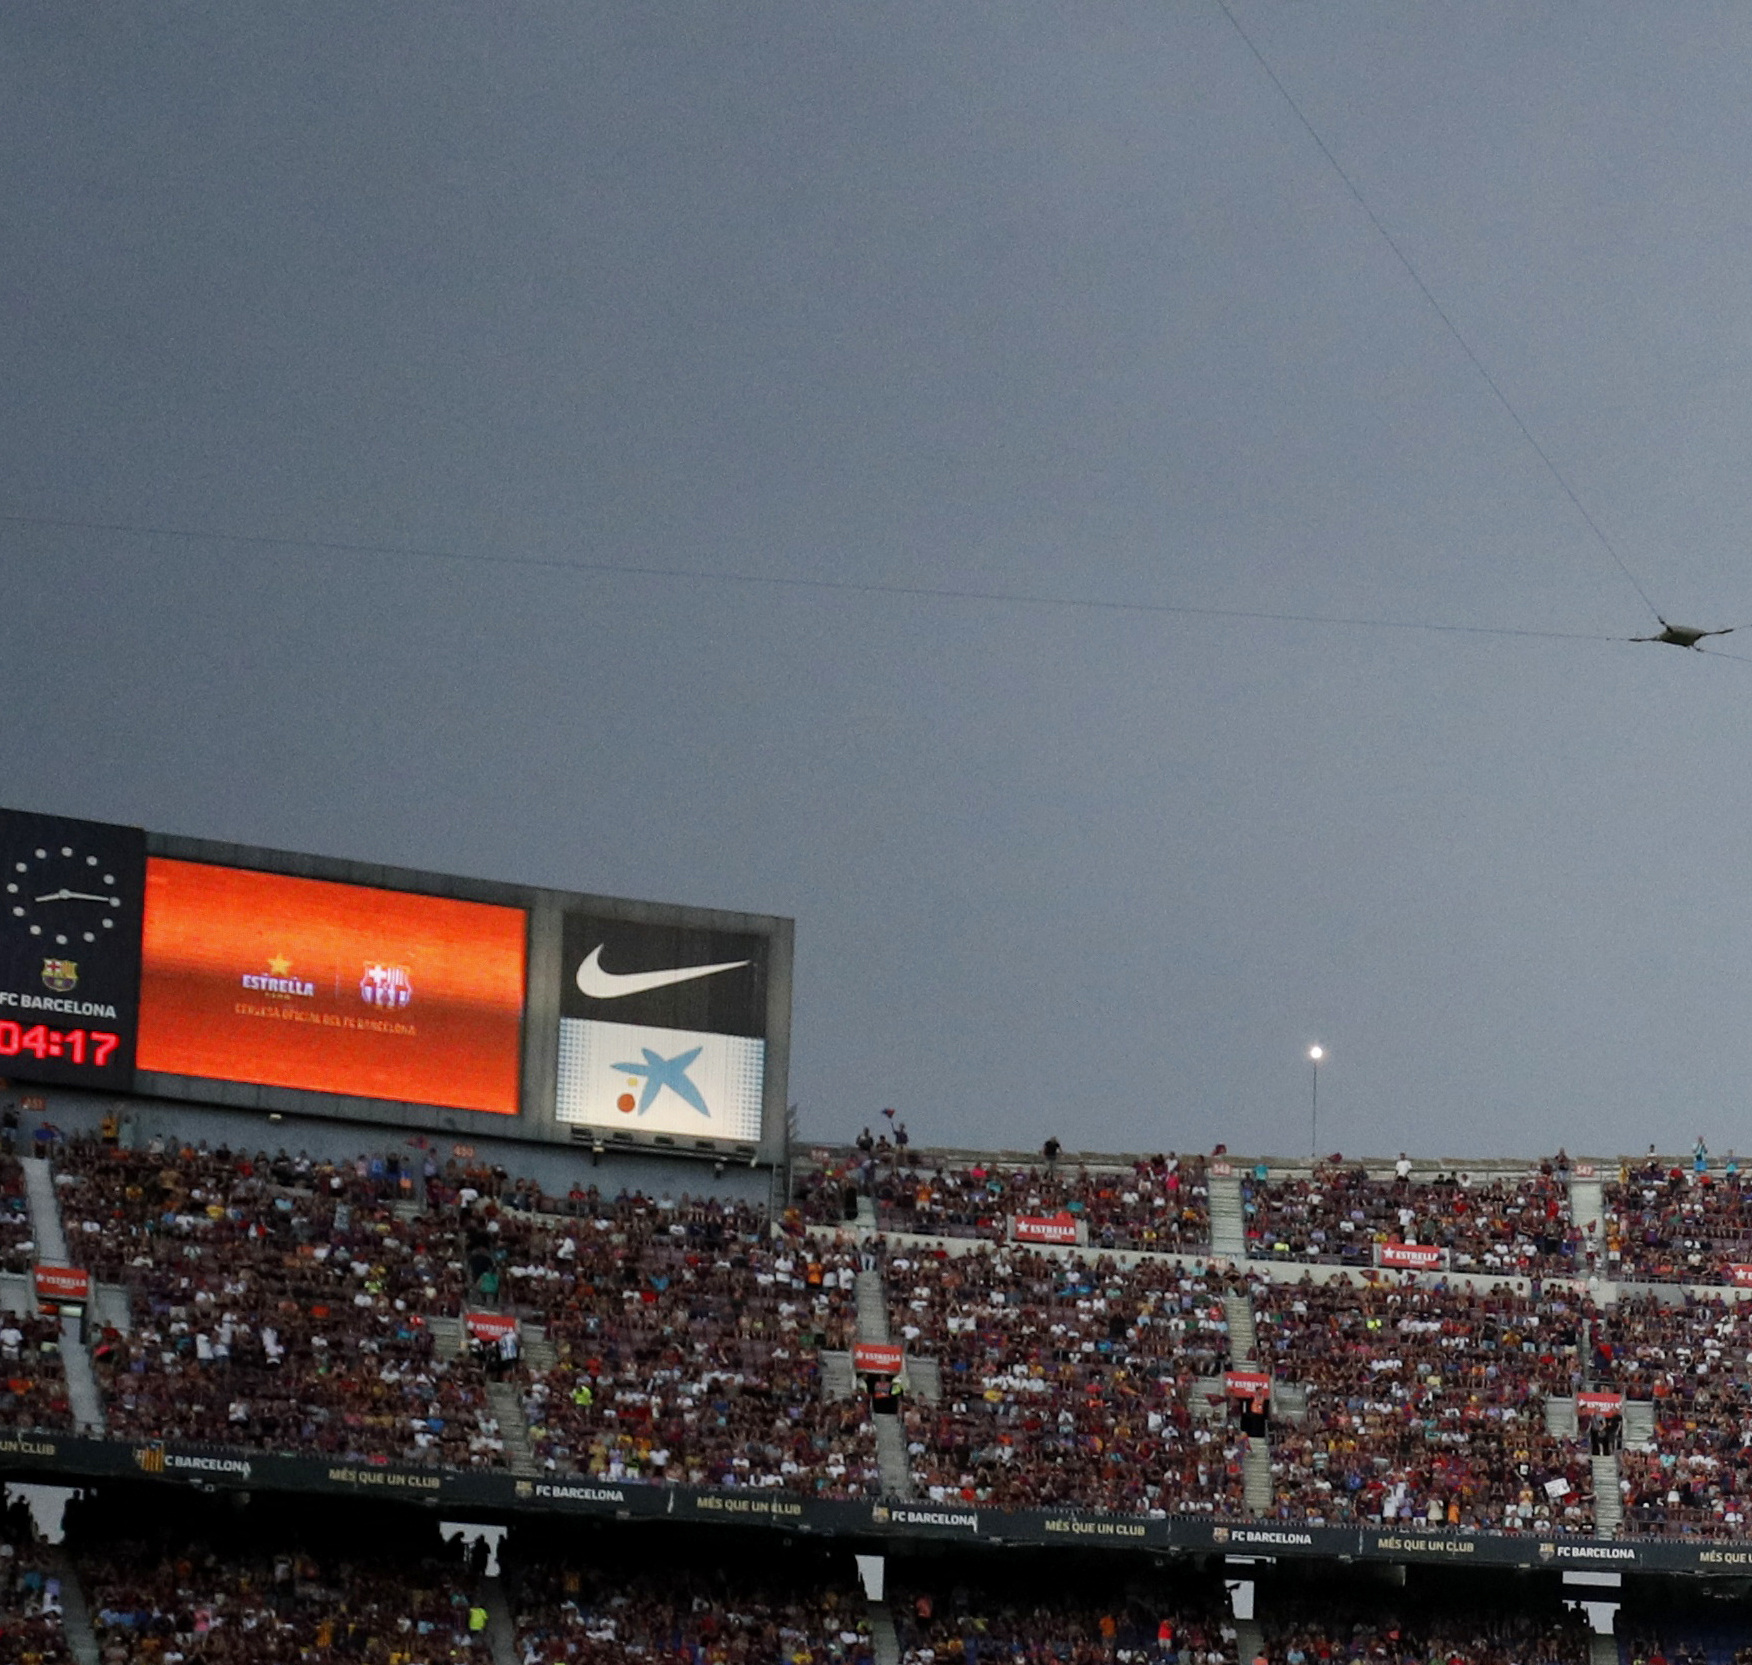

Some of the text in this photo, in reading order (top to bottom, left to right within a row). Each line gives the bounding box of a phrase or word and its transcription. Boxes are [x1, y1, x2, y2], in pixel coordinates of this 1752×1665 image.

[242, 973, 315, 998] ESTRELLA
[0, 991, 117, 1019] FC BARCELONA
[0, 1021, 119, 1067] 04:17
[20, 1442, 55, 1456] CLUB
[175, 1456, 250, 1475] BARCELONA
[329, 1467, 440, 1489] MÉS QUE UN CLUB
[536, 1484, 624, 1502] FC BARCELONA
[697, 1496, 801, 1516] MÉS QUE UN CLUB
[892, 1510, 976, 1527] FC BARCELONA
[1045, 1518, 1145, 1536] MÉS QUE UN CLUB
[1232, 1530, 1312, 1545] FC BARCELONA
[1378, 1536, 1474, 1553] MÉS QUE UN CLUB
[1557, 1546, 1635, 1560] FC BARCELONA
[1700, 1550, 1723, 1563] MÉS
[1724, 1553, 1746, 1565] QUE
